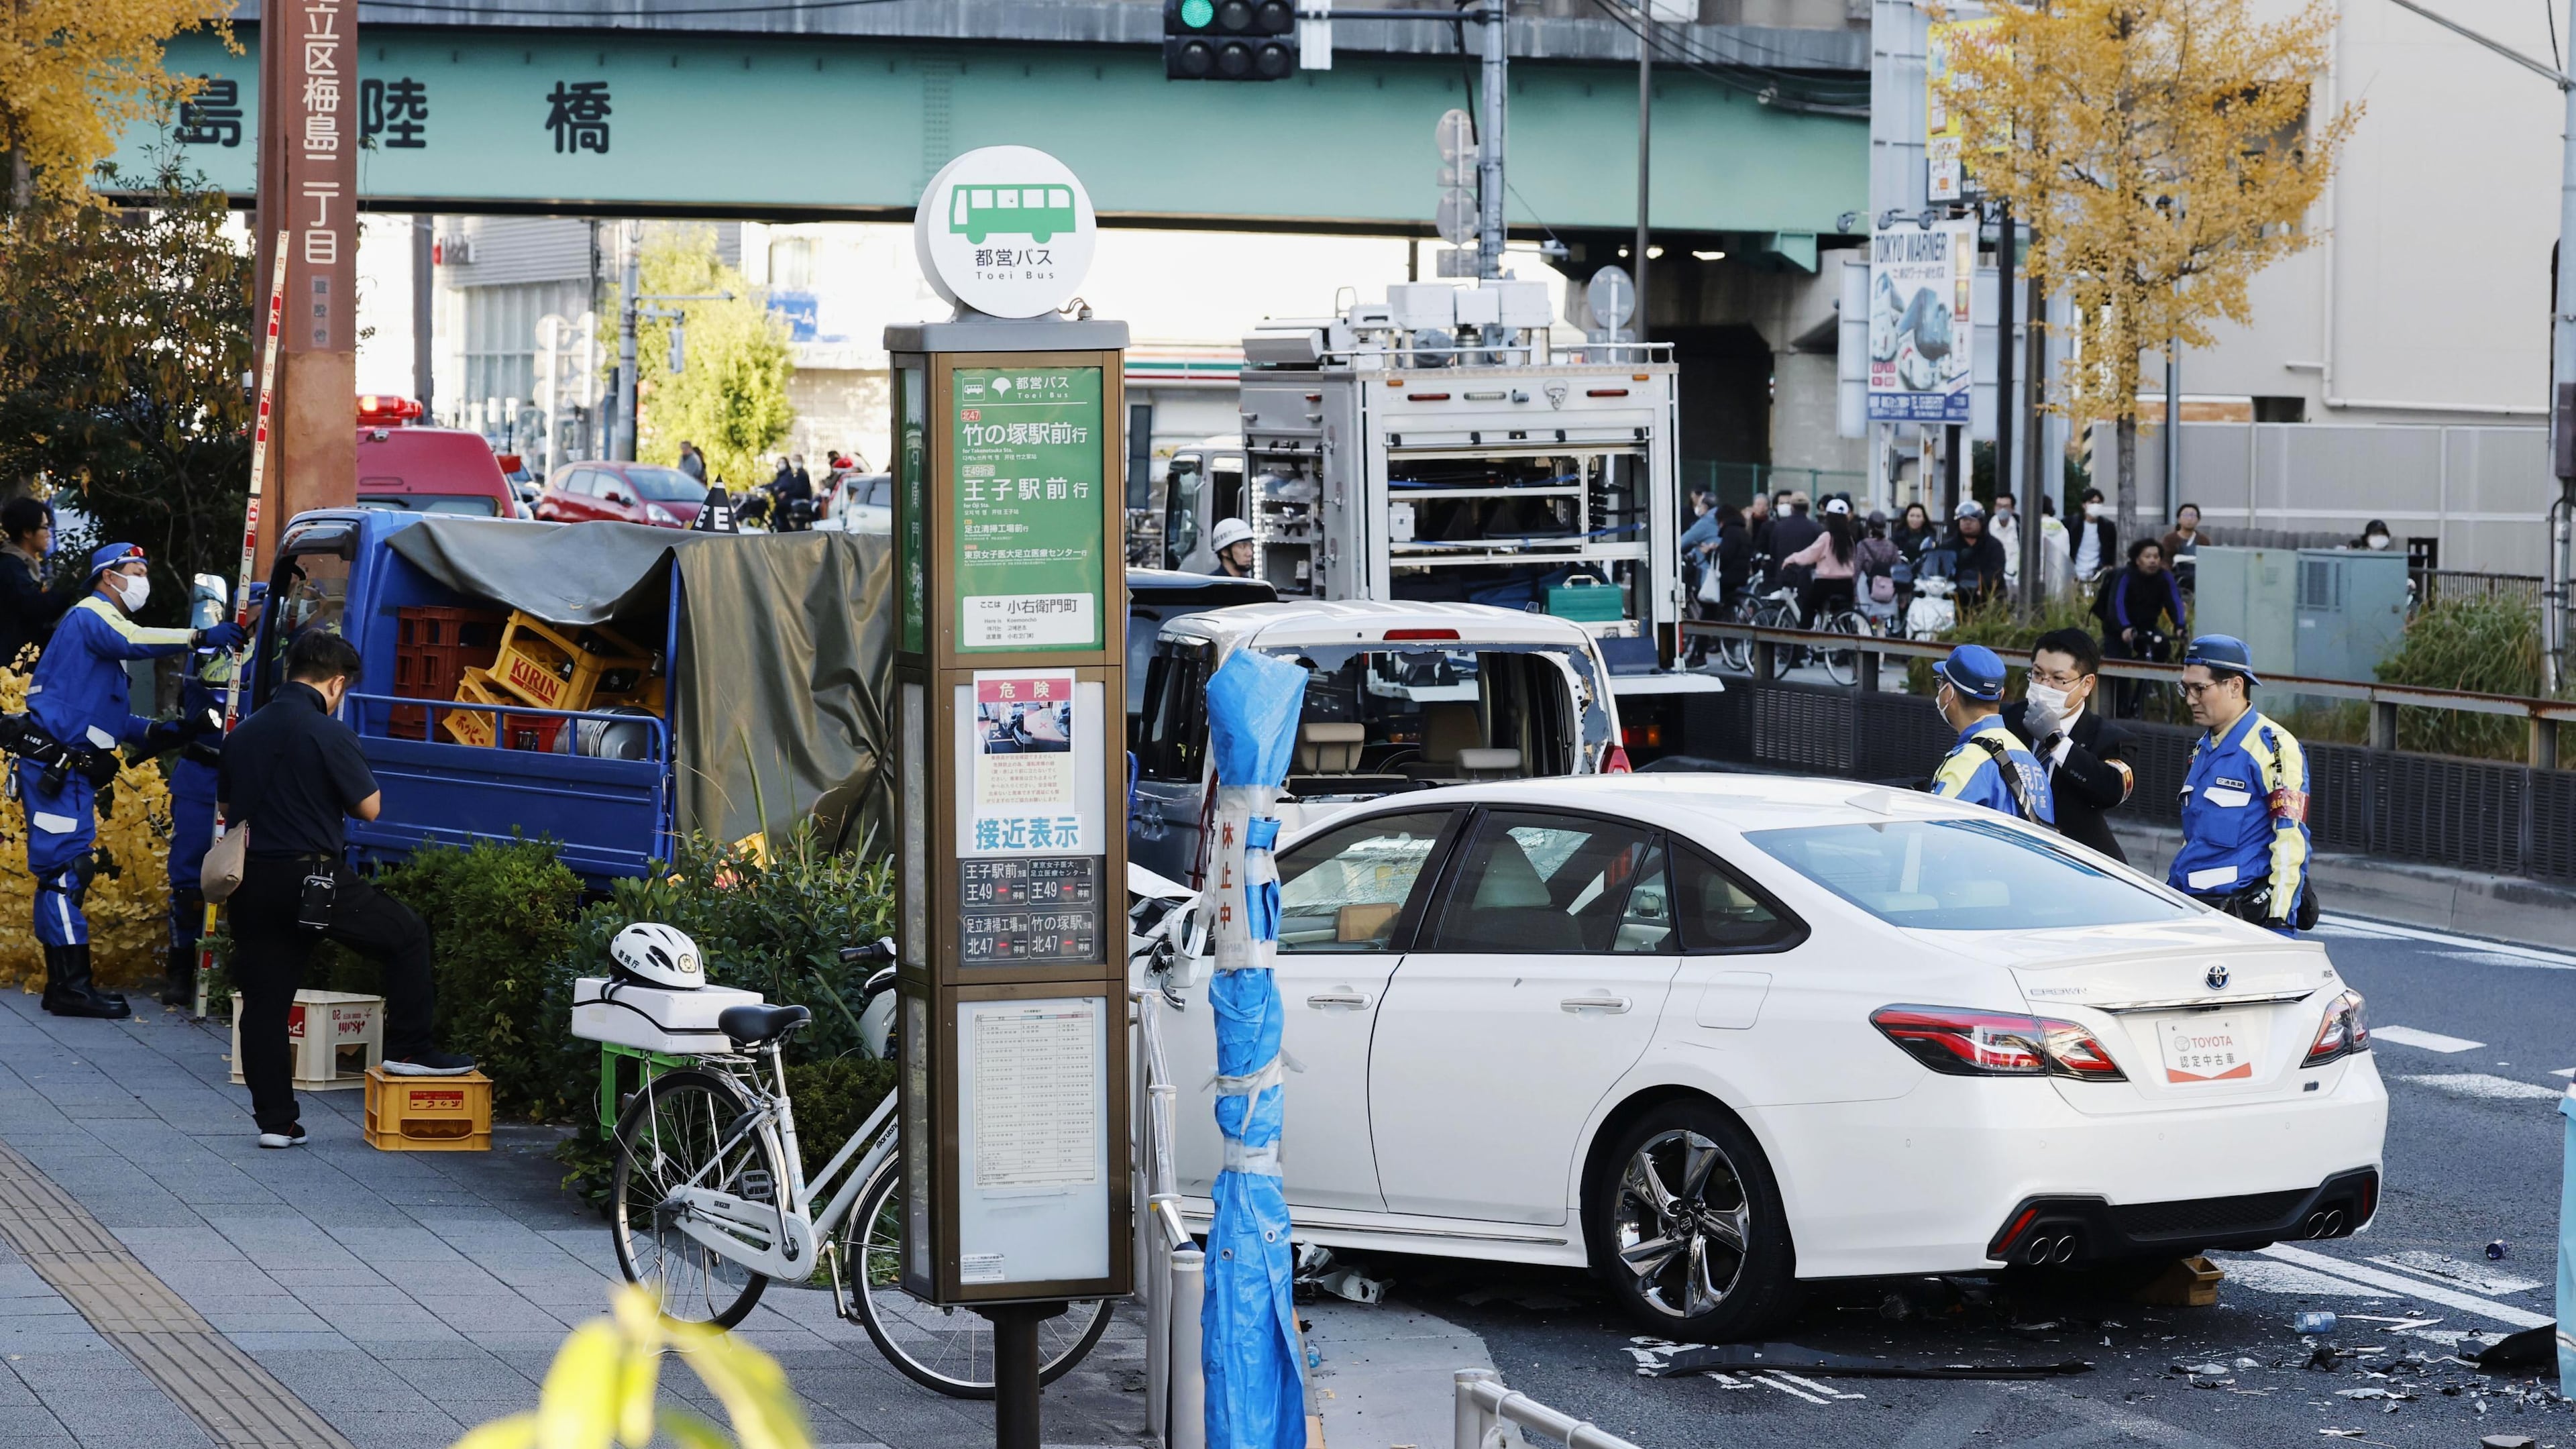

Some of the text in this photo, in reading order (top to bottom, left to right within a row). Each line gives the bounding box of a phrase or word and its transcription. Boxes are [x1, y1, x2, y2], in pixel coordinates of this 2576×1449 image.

[302, 0, 341, 264] 立区梅島二丁目
[1875, 232, 1947, 263] TOKYO WARNER
[975, 248, 1053, 267] 都営バス
[976, 271, 1054, 280] Toei Bus
[1016, 376, 1069, 390] 都営バス
[963, 411, 979, 421] 北47
[962, 422, 1087, 446] 竹の塚駅前行
[964, 477, 1089, 501] 王子駅前行
[714, 506, 730, 530] E
[1008, 599, 1077, 614] 小右衛門町
[511, 657, 559, 700] KIRIN
[999, 681, 1050, 698] 危険
[976, 816, 1078, 850] 接近表示
[1220, 822, 1234, 930] 休止中
[967, 883, 993, 901] 王49
[1032, 881, 1057, 899] 王49
[967, 938, 993, 955] 北47
[1032, 935, 1058, 953] 北47
[618, 949, 640, 969] 警視庁
[337, 1020, 365, 1036] Asahi
[2191, 1035, 2233, 1047] TOYOTA
[2179, 1053, 2235, 1069] 認定中古車
